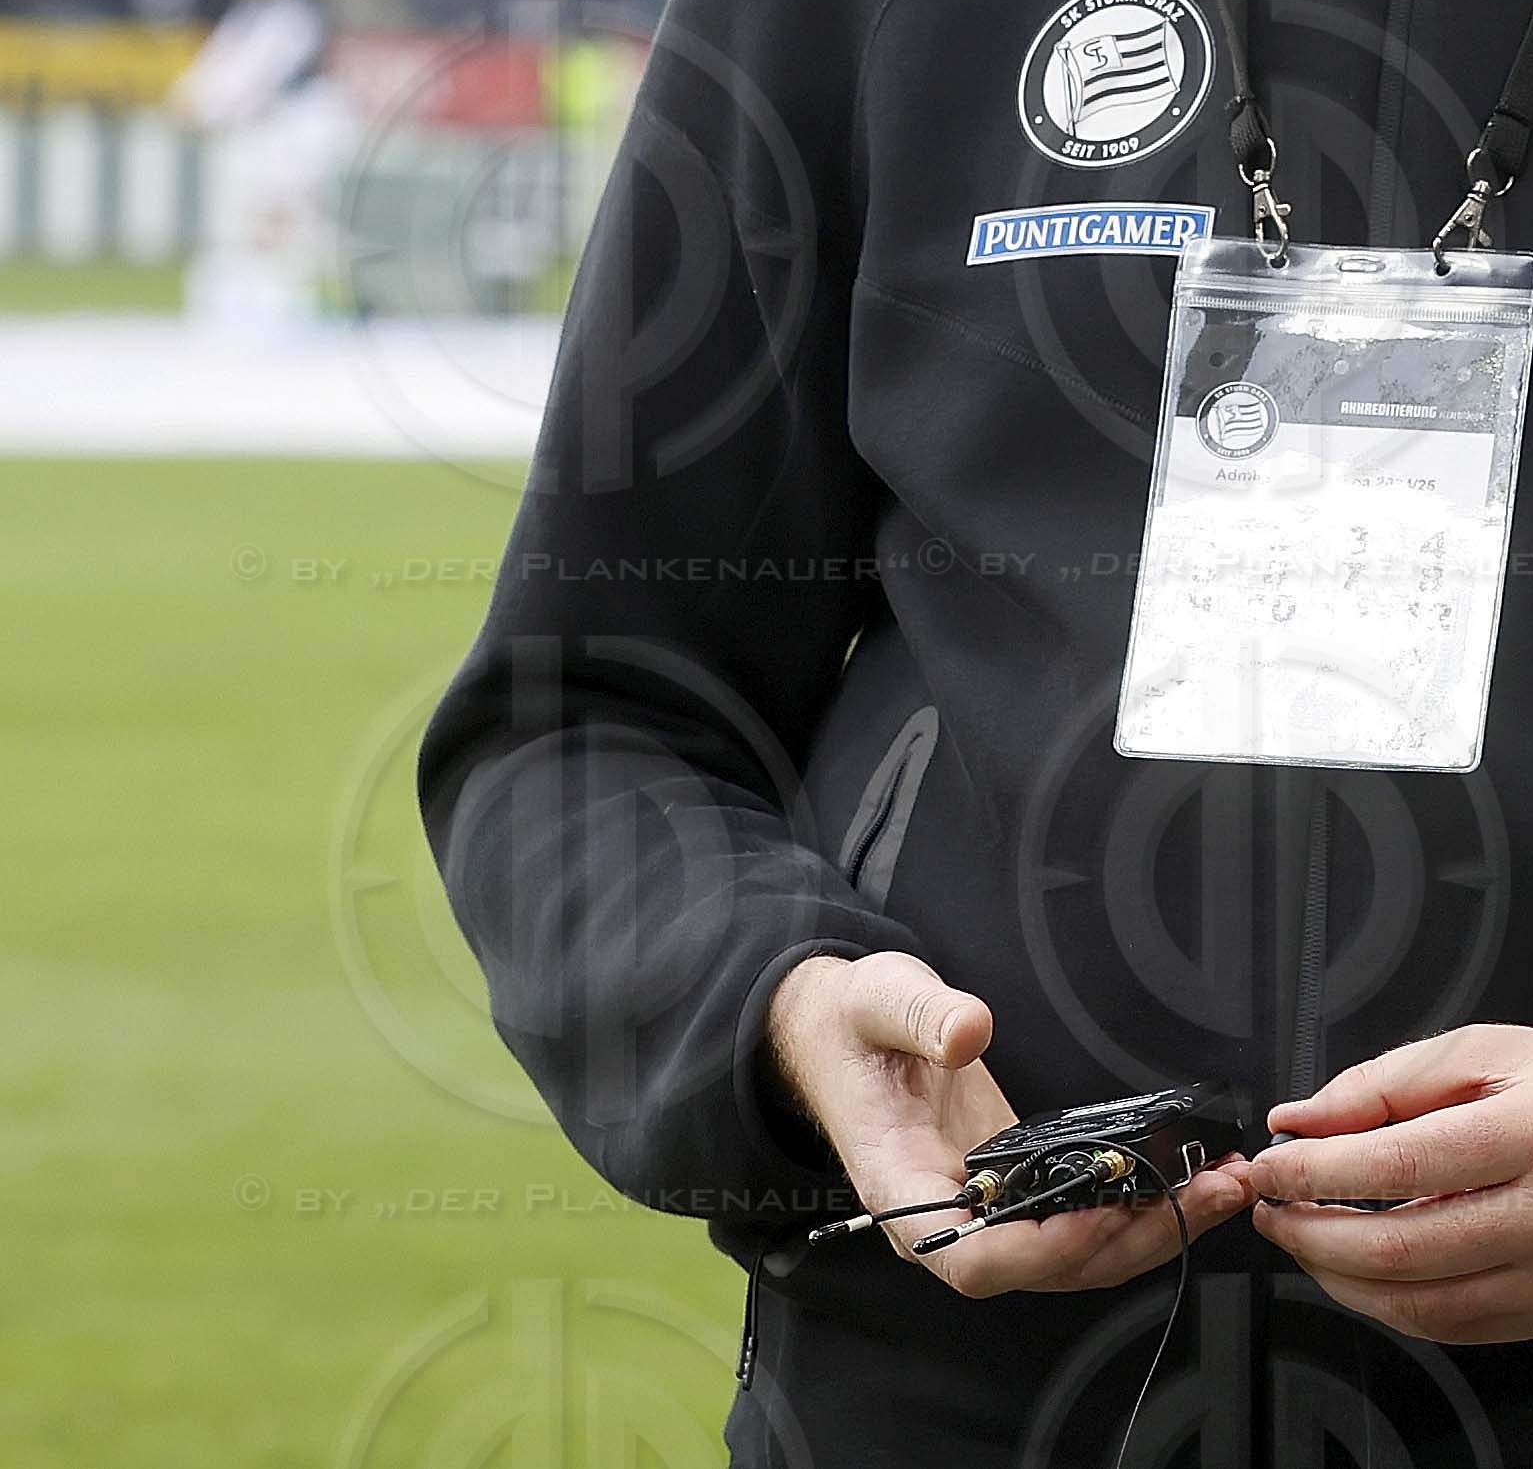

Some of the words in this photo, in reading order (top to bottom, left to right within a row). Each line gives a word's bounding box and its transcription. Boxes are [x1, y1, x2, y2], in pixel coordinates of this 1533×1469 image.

[1060, 9, 1083, 29] SK
[1061, 140, 1095, 159] SEIT
[1102, 137, 1140, 159] 1909
[982, 214, 1197, 256] PUNTIGAMER
